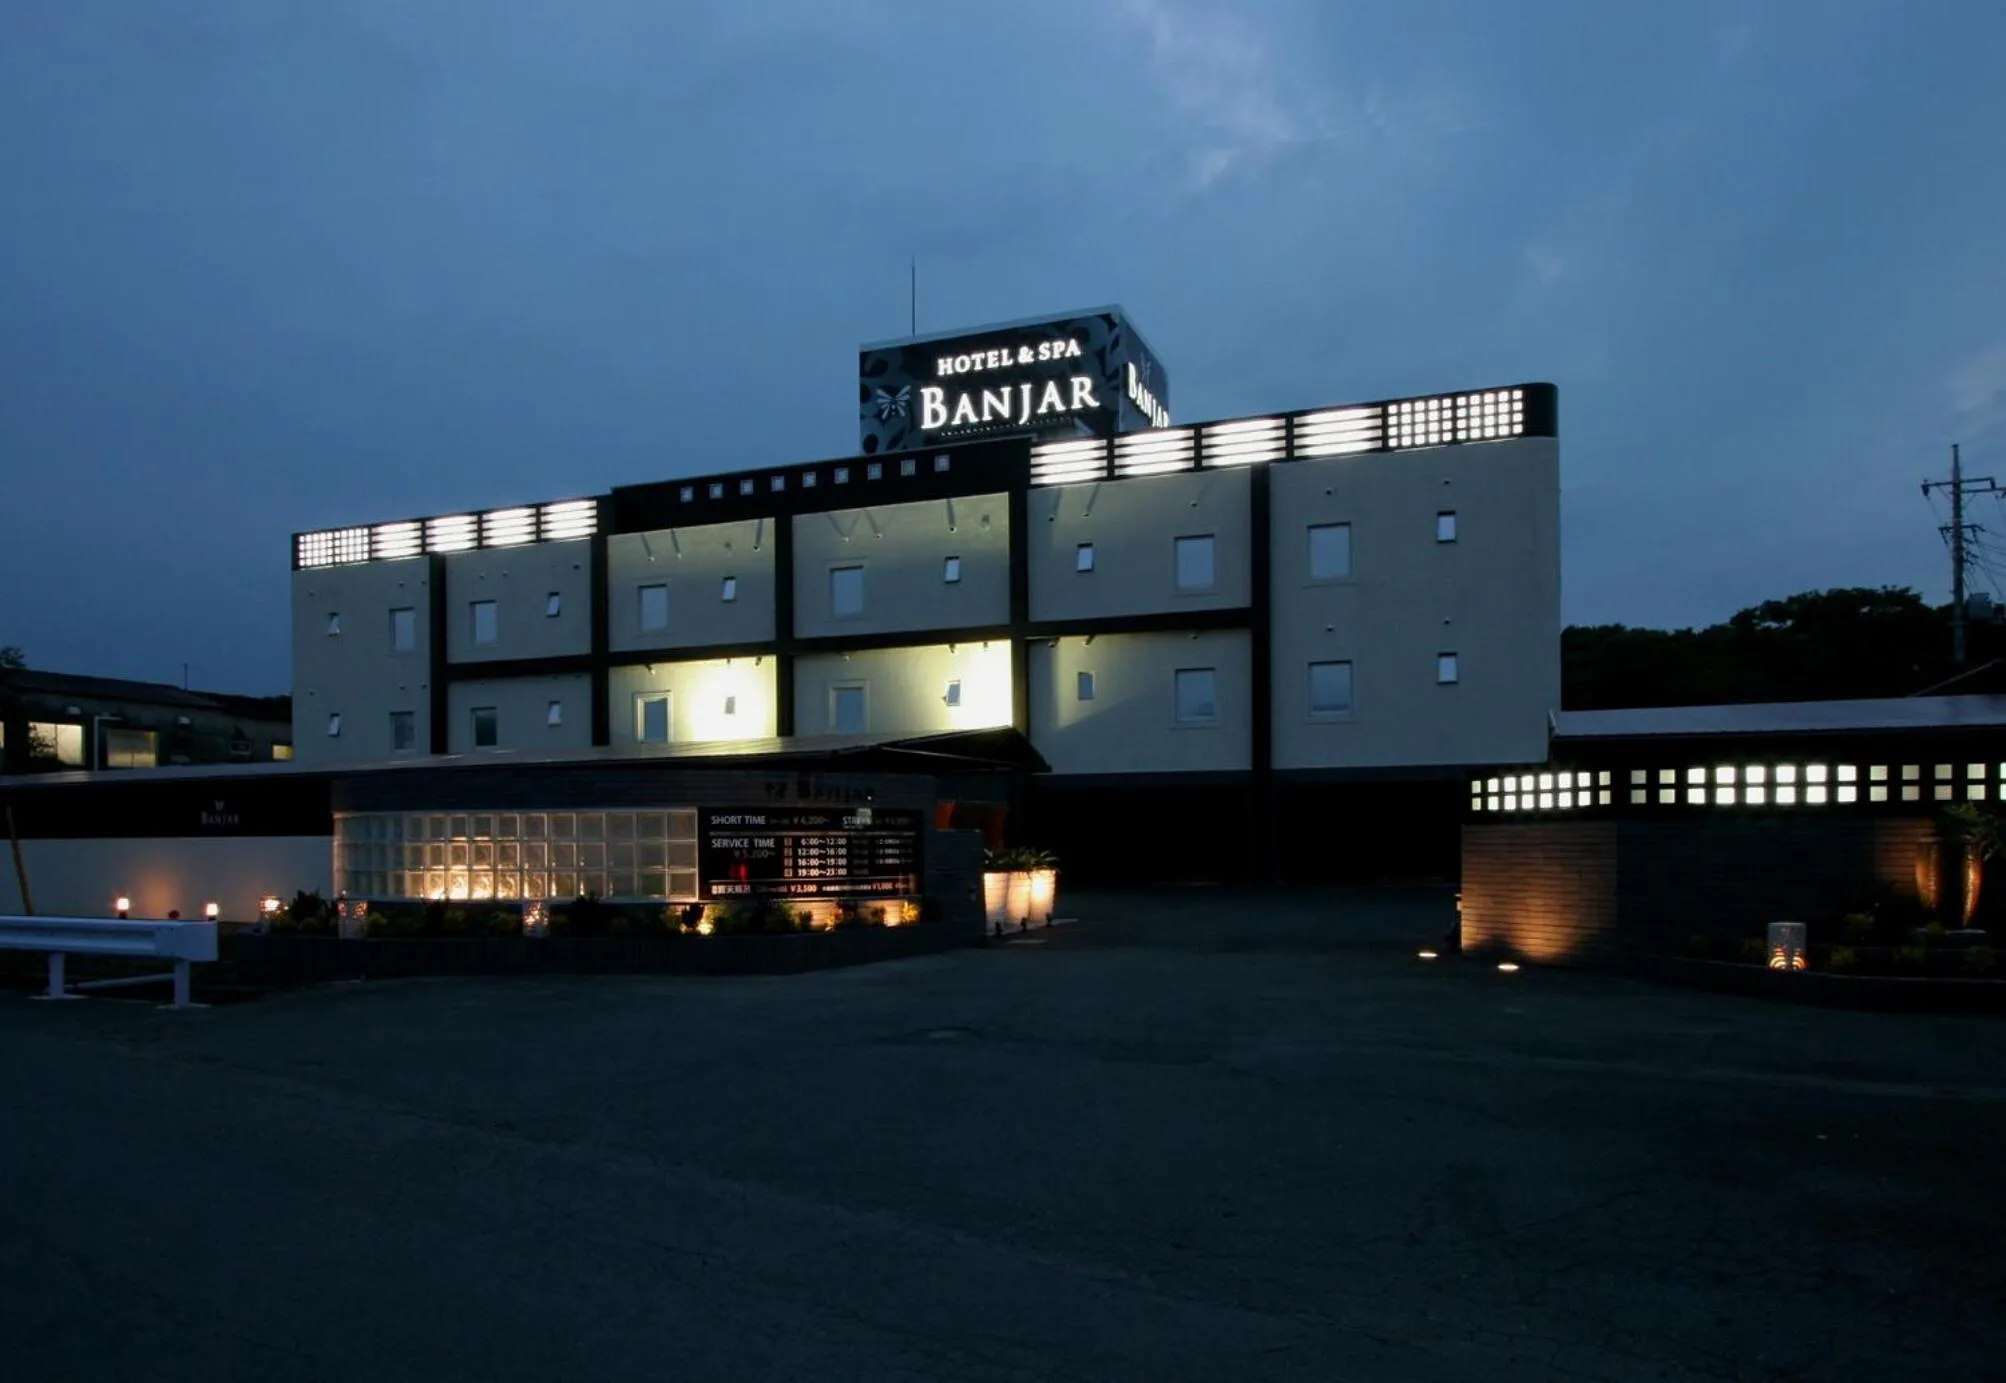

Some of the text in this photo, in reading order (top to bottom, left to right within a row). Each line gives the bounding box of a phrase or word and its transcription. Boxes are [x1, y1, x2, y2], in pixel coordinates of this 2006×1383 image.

[937, 338, 1081, 376] HOTEL & SPA
[919, 376, 1100, 430] BANJAR
[1128, 361, 1170, 428] BANJAR
[710, 815, 743, 826] SHORT
[745, 815, 767, 825] TIME
[711, 838, 776, 848] SERVICE TIME
